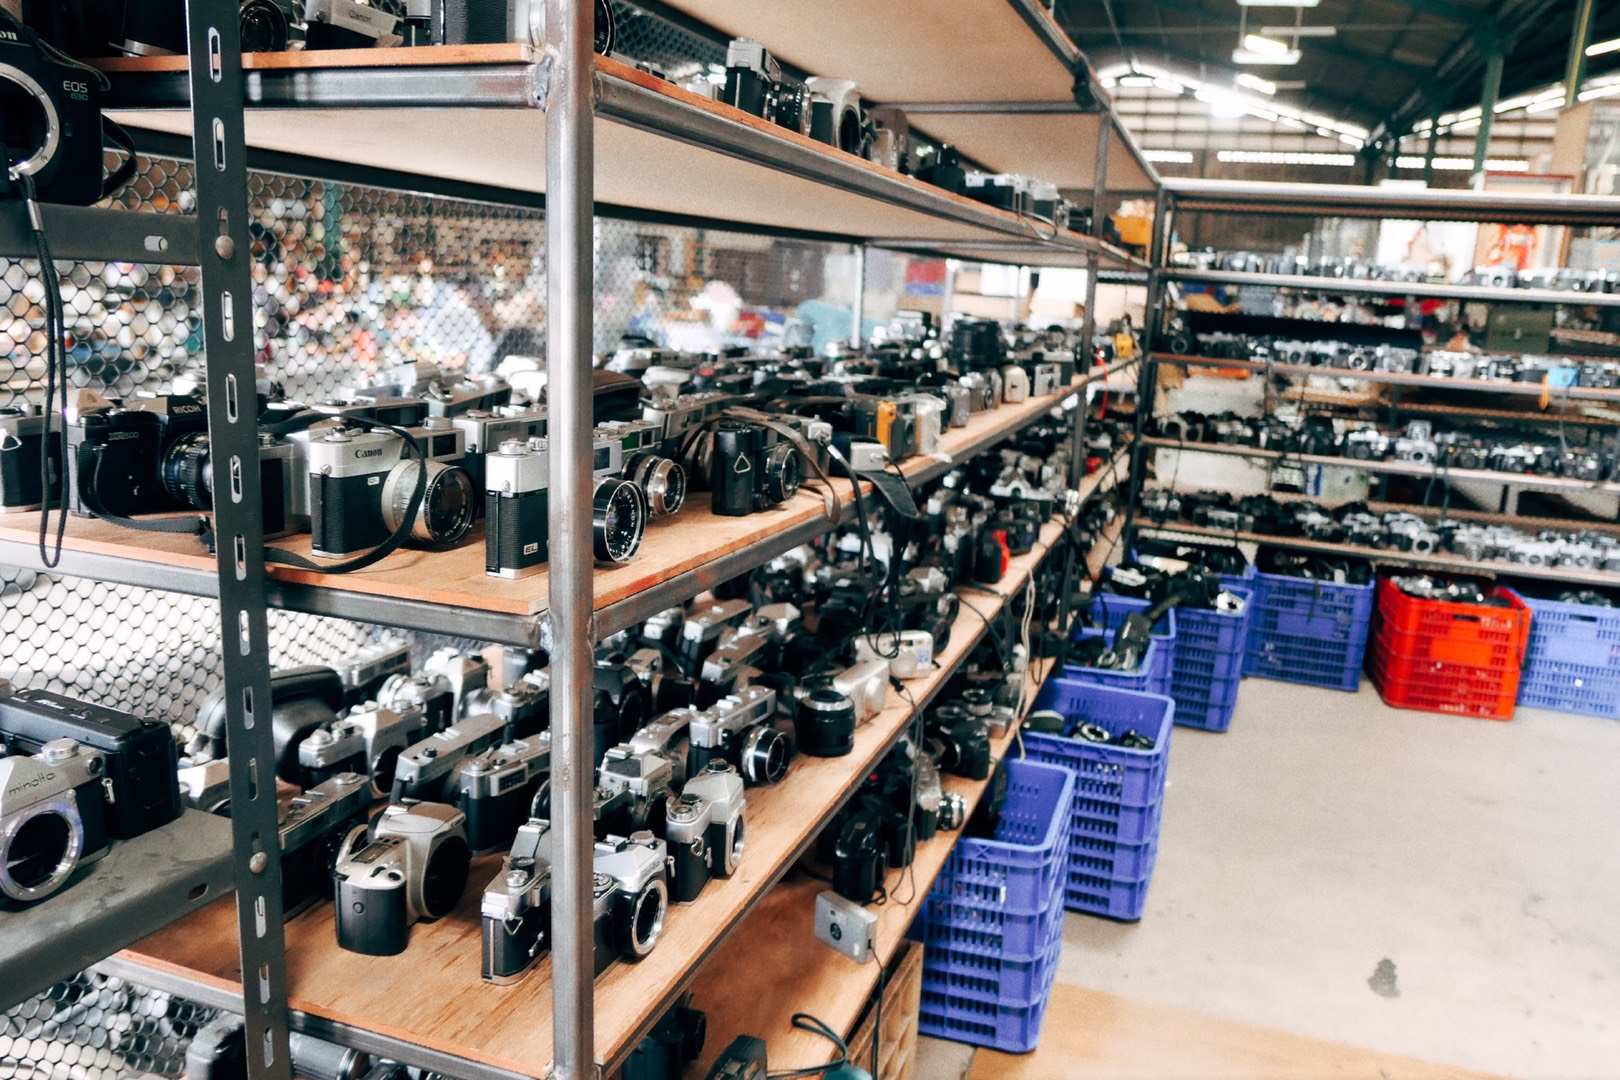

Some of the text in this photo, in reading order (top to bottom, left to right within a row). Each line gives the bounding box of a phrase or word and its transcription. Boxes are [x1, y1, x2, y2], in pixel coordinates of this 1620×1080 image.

[63, 80, 88, 93] EOS
[355, 448, 383, 459] Canon
[9, 771, 57, 796] minolta
